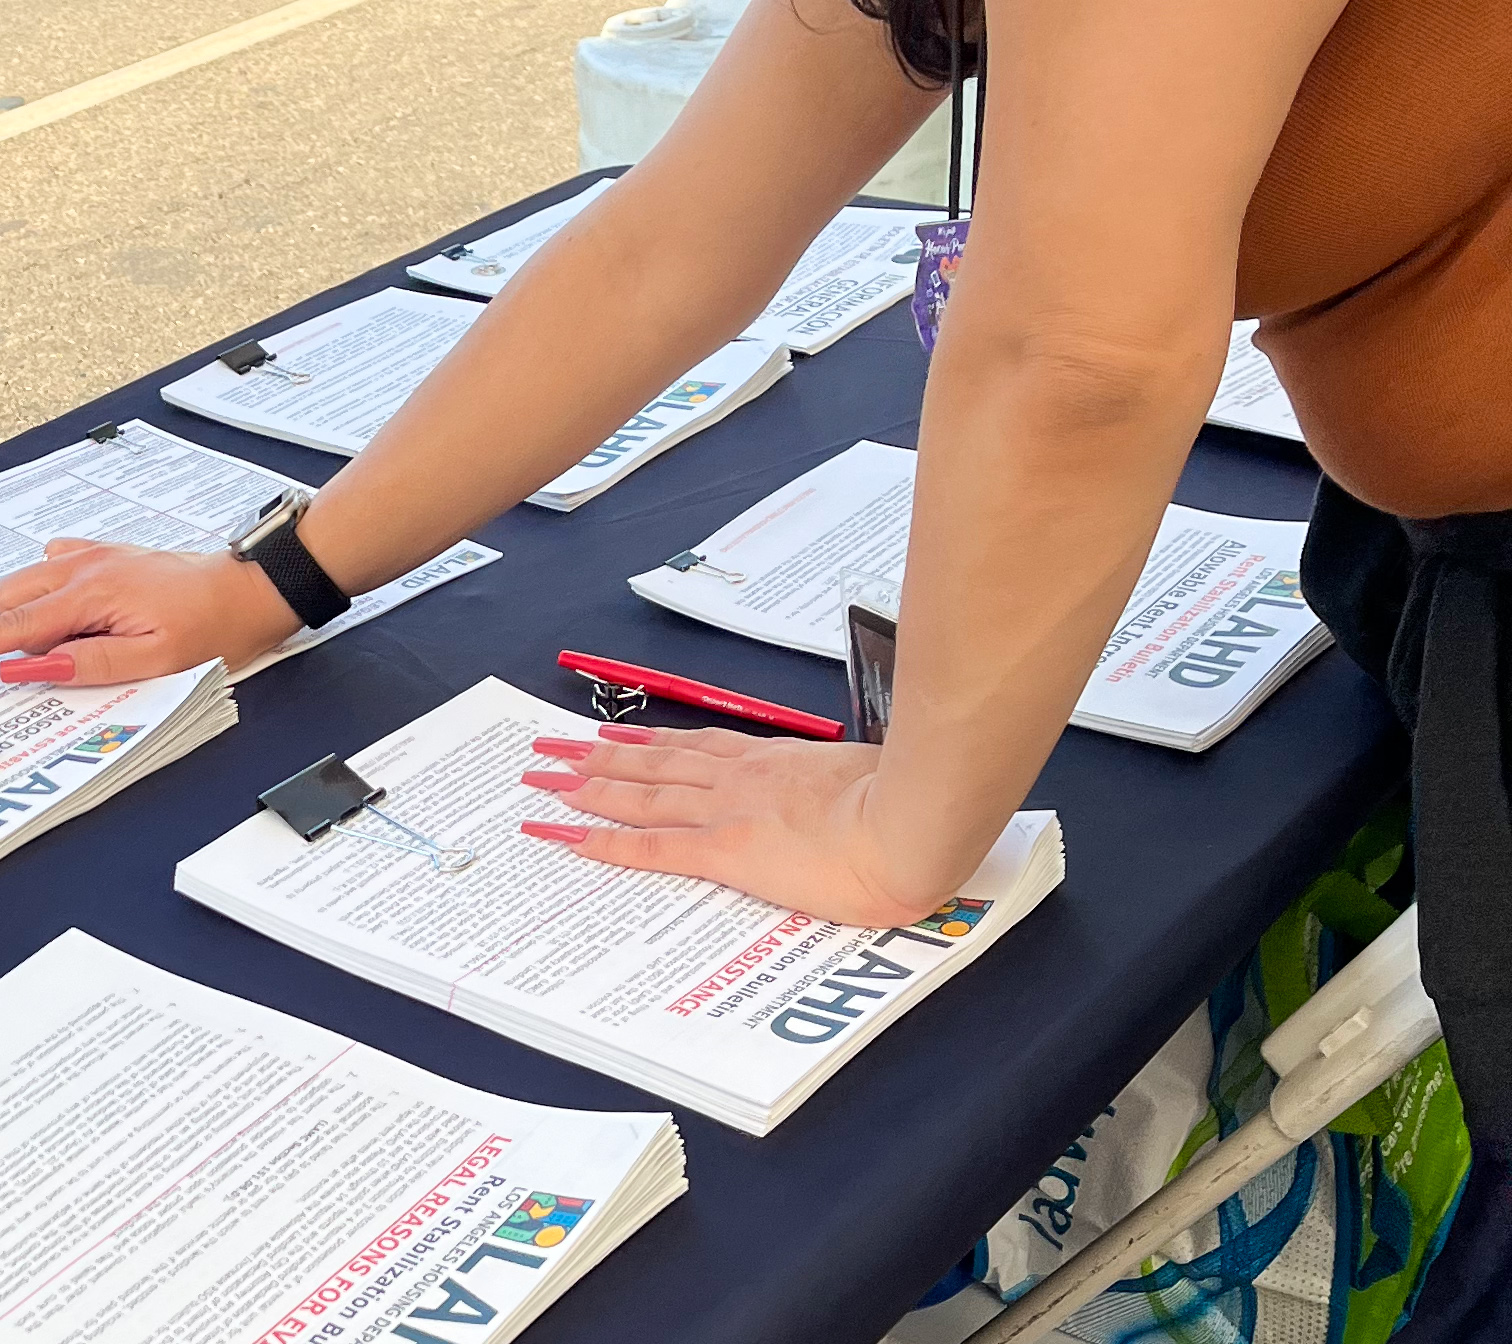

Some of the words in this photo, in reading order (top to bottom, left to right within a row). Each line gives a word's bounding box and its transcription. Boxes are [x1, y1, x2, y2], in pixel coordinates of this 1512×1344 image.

[780, 278, 858, 317] GENERAL
[576, 396, 695, 468] LAHD
[400, 558, 467, 588] LAHD
[1168, 540, 1246, 598] Allowable
[1226, 553, 1267, 578] Rent
[1130, 599, 1179, 629] Rent
[1154, 578, 1237, 641] Stabilization
[1191, 607, 1231, 637] HOUSING
[1105, 642, 1164, 682] Bulletin
[1144, 636, 1199, 678] DEPARTMENT
[1168, 596, 1305, 689] LAHD
[13, 706, 75, 741] PAGOS
[669, 934, 782, 1016] ASSISTANCE
[810, 938, 865, 975] HOUSING
[706, 972, 777, 1017] Bulletin
[742, 974, 818, 1029] DEPARTMENT
[771, 924, 950, 1044] LAHD
[438, 1135, 512, 1186] LEGAL
[454, 1174, 506, 1214] Rent
[497, 1186, 528, 1210] LOS
[348, 1190, 450, 1276] REASONS
[441, 1210, 501, 1263] ANGELES
[339, 1215, 461, 1318] Stabilization
[299, 1275, 354, 1315] FOR
[384, 1263, 448, 1317] HOUSING
